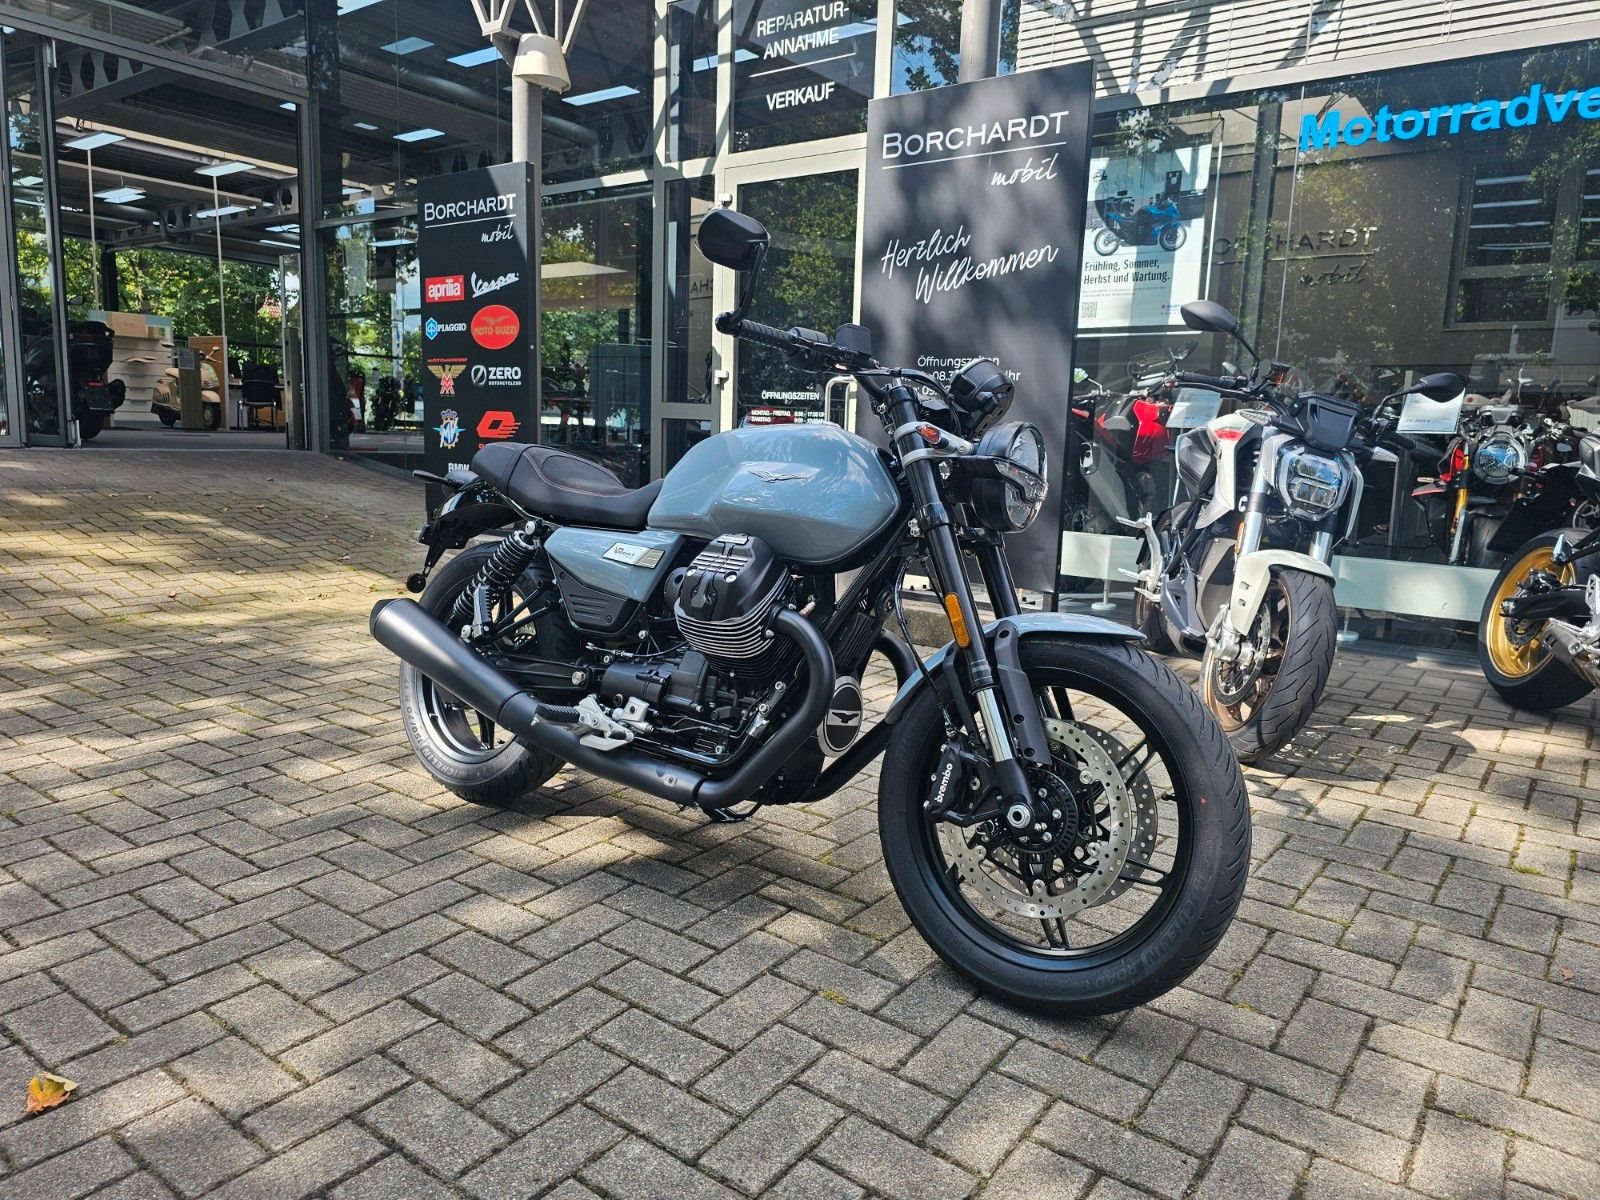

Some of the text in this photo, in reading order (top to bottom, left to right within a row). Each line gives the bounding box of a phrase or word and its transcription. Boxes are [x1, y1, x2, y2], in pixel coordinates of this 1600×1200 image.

[757, 1, 849, 37] REPARATUR-
[764, 27, 839, 60] ANNAHME
[766, 82, 835, 111] VERKAUF
[1300, 84, 1600, 152] Motorradve
[882, 111, 1069, 159] BORCHARDT
[991, 153, 1059, 187] mobil
[424, 193, 516, 221] BORCHARDT
[481, 221, 514, 242] mobil
[881, 225, 971, 279] Herzlich
[1084, 259, 1160, 272] Frühling, Sommer,
[428, 271, 519, 300] aprilia Vespa
[916, 244, 1059, 304] Willkommen
[1084, 270, 1170, 285] Herbst und Wartung.
[438, 322, 517, 336] PIAGGIO MOTO GUZZI
[488, 366, 522, 380] ZERO
[917, 354, 1000, 370] Öffnungszn
[761, 390, 820, 400] ÖFFNUNGSZEITEN
[448, 463, 470, 473] BMW
[934, 763, 953, 803] brembo
